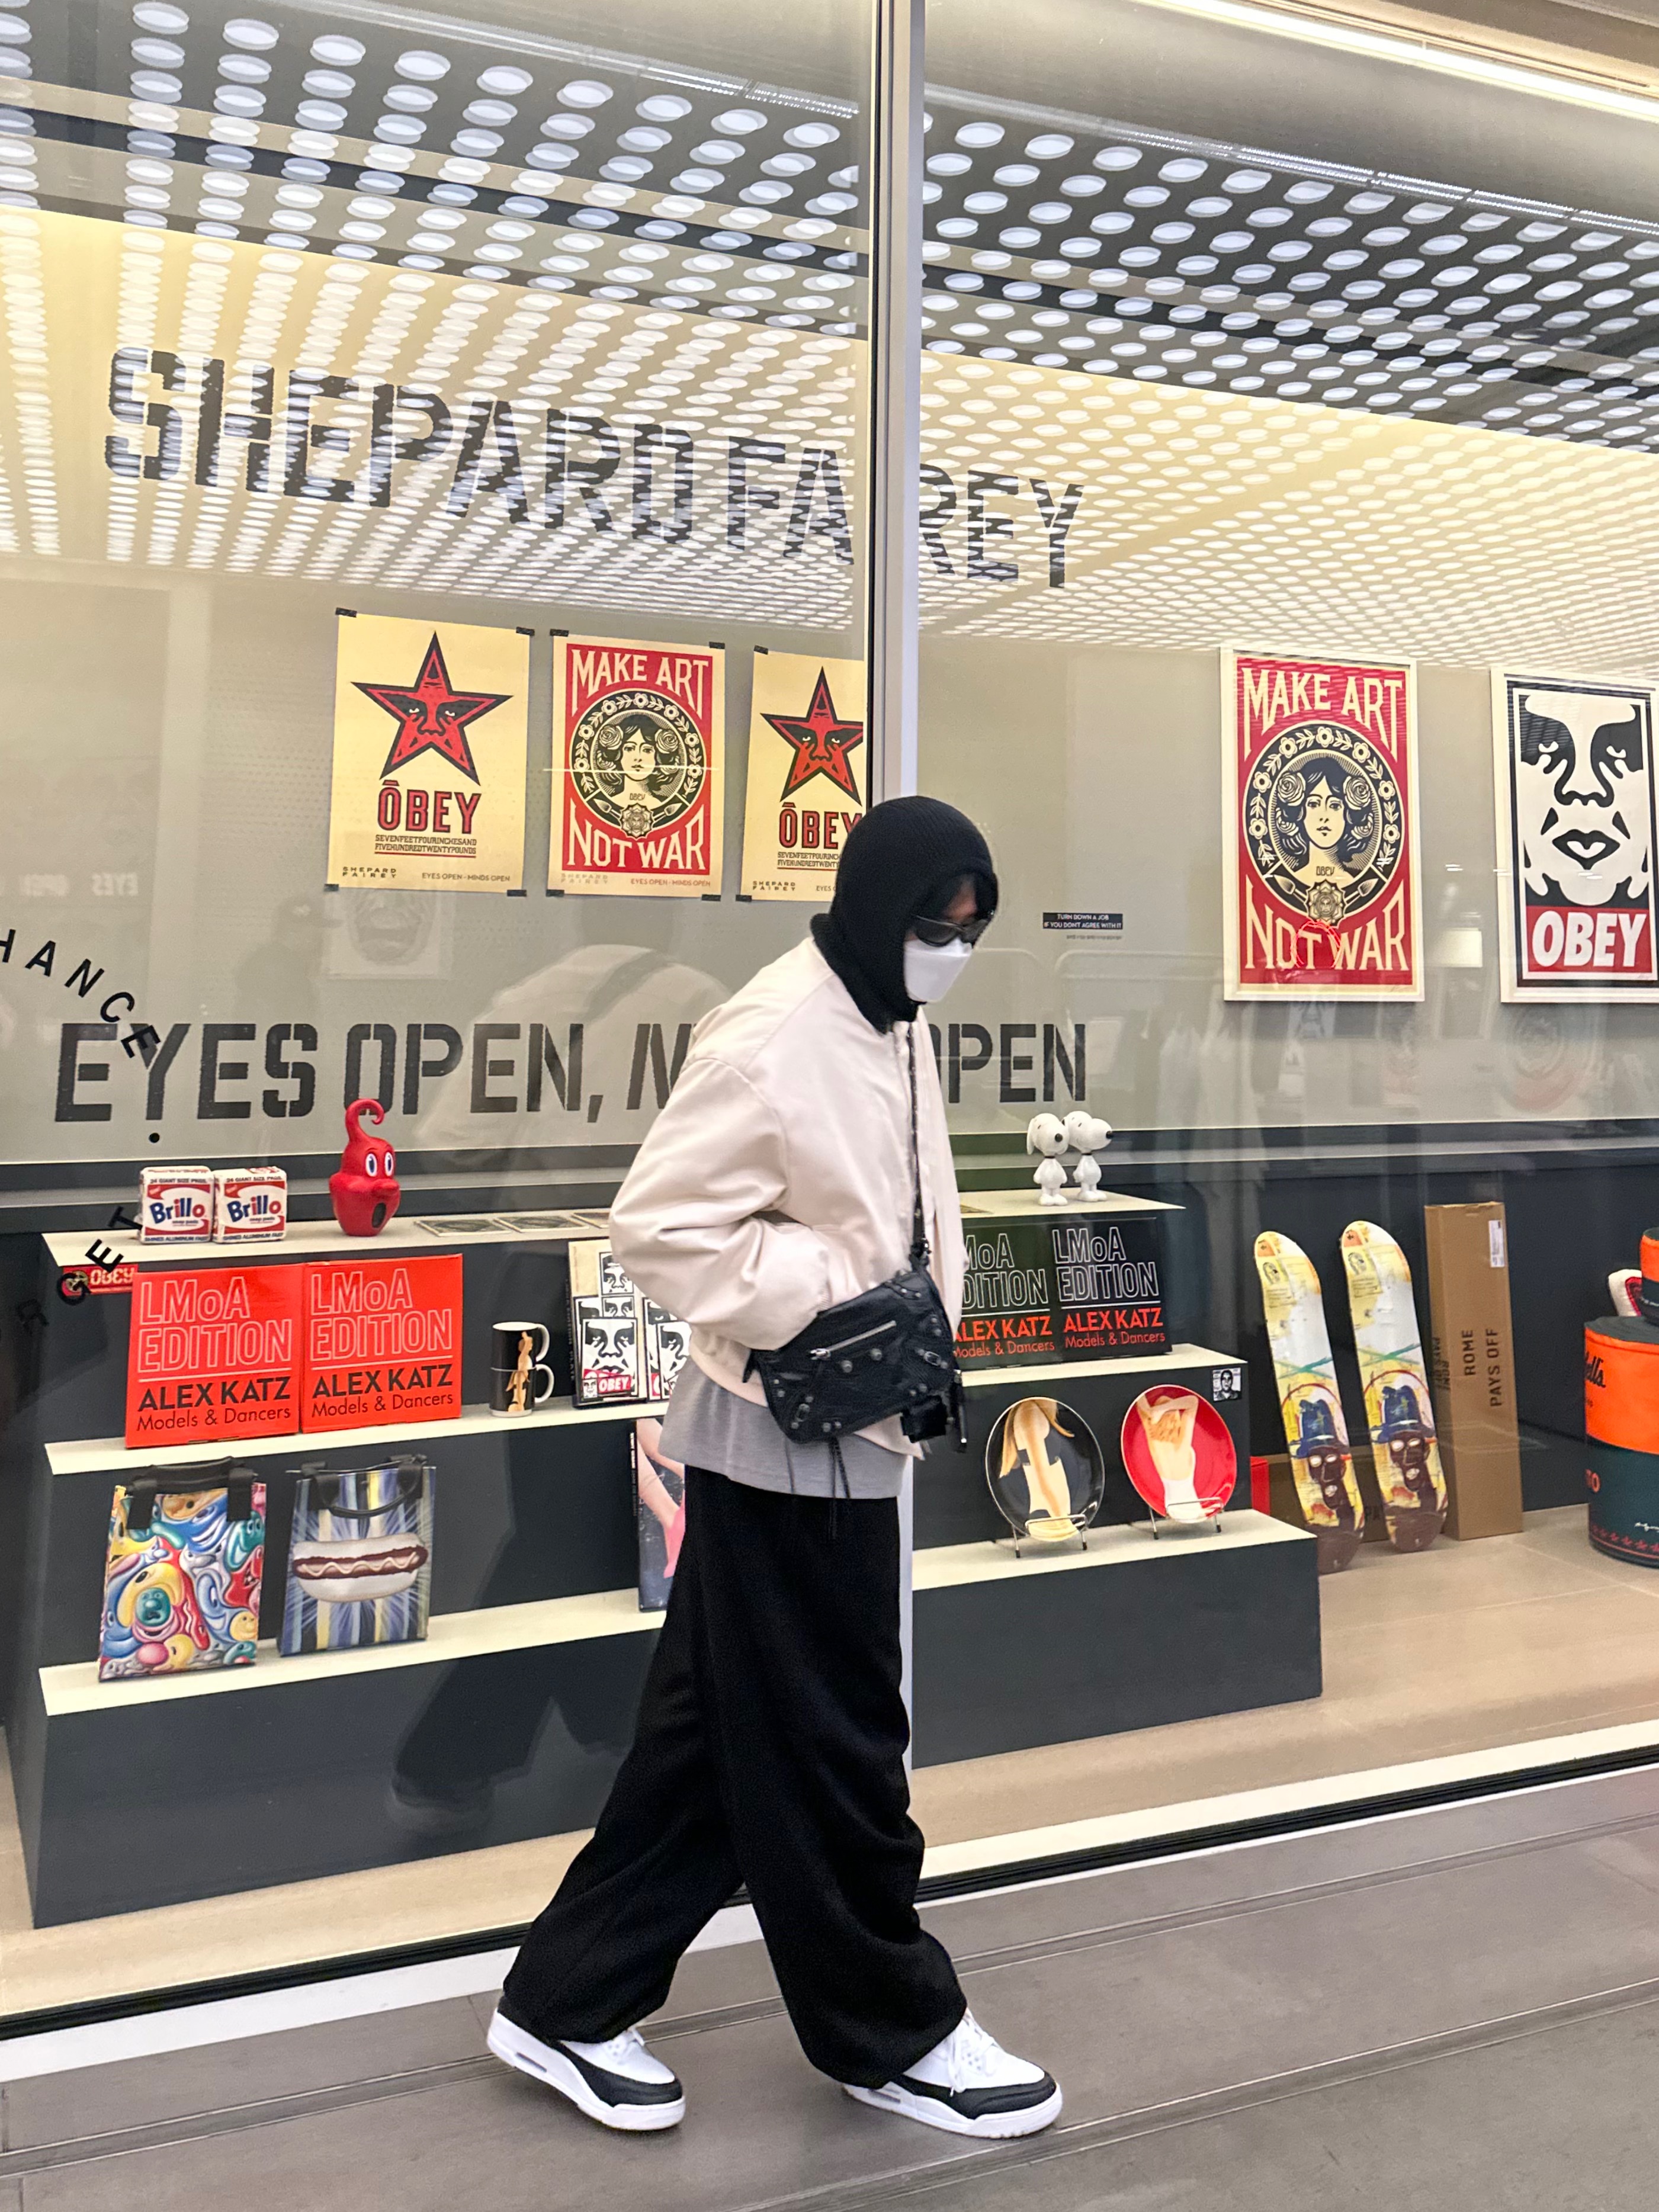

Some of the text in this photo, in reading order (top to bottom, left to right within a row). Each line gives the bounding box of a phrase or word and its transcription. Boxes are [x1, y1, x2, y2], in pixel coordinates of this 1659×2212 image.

[105, 347, 694, 544] SHEPARD
[571, 648, 708, 719] MAKE ART
[1241, 667, 1403, 762] MAKE ART
[567, 798, 706, 871] NOT WAR
[1245, 875, 1409, 971] NOT WAR
[1531, 911, 1647, 968] OBEY
[56, 1023, 318, 1122] EYES
[344, 1023, 604, 1123] OPEN,
[150, 1198, 206, 1224] Brillo
[227, 1195, 281, 1222] Brillo
[1052, 1227, 1127, 1264] LMoA
[140, 1276, 250, 1325] LMoA
[310, 1268, 413, 1315] LMoA
[961, 1269, 1048, 1310] DITION
[1057, 1261, 1159, 1302] EDITION
[310, 1308, 452, 1362] EDITION
[1002, 1316, 1052, 1338] KATZ
[1064, 1308, 1163, 1333] ALEX KATZ
[1066, 1331, 1165, 1349] Models & Dancers
[137, 1319, 292, 1373] EDITION
[995, 1341, 1004, 1355] &
[1007, 1341, 1055, 1354] Dancers
[1461, 1330, 1475, 1376] ROME
[312, 1363, 453, 1399] ALEX KATZ
[599, 1377, 630, 1392] OBEY
[1485, 1328, 1503, 1407] PAYS OFF
[137, 1376, 291, 1412] ALEX KATZ
[312, 1392, 453, 1418] Models & Dancers
[136, 1407, 291, 1431] Models & Dancers
